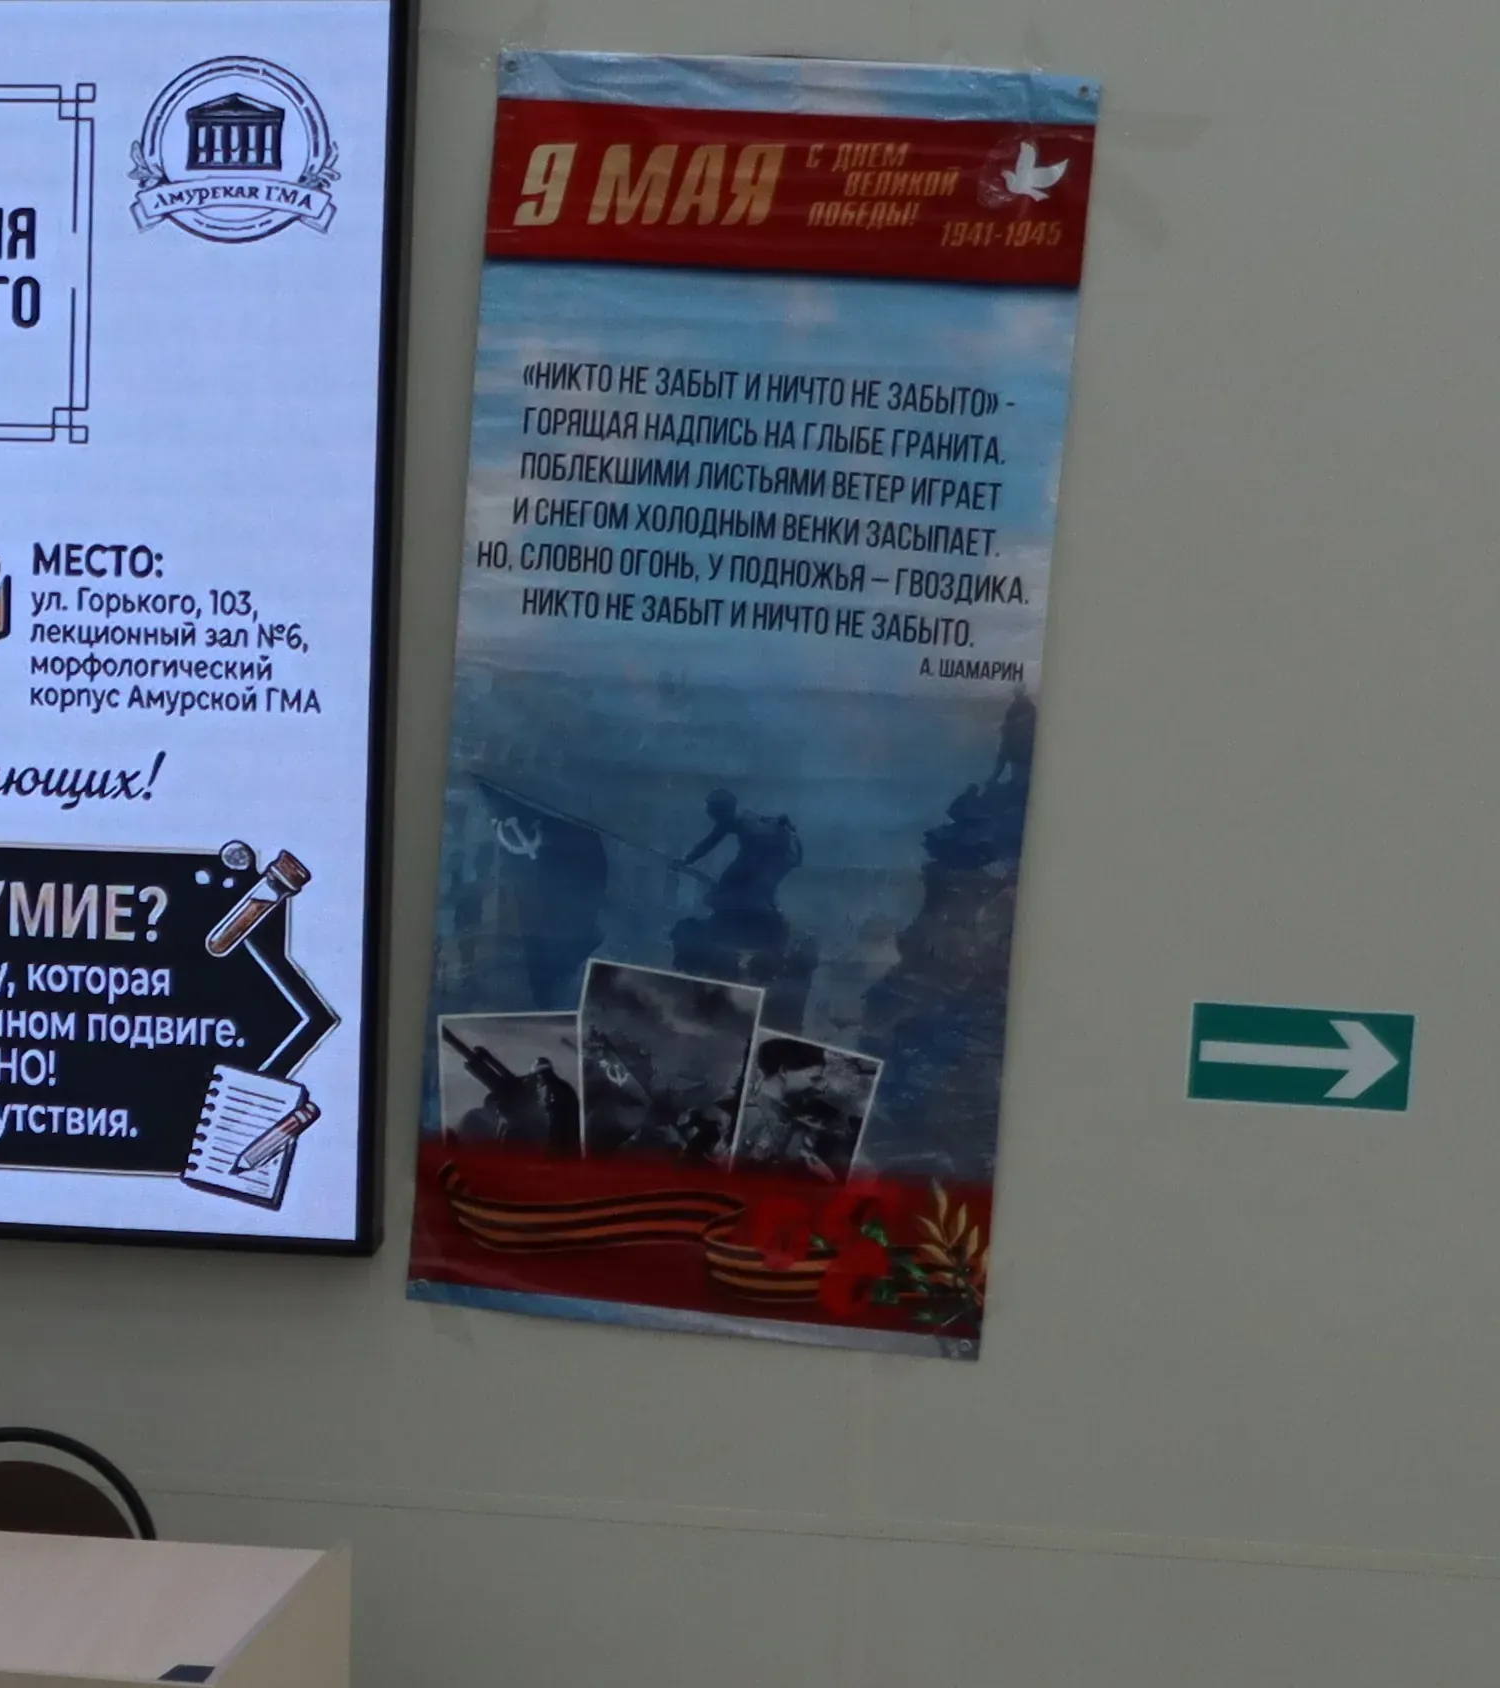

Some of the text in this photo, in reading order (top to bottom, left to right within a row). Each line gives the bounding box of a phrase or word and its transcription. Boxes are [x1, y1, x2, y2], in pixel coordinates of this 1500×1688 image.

[832, 143, 911, 172] ДНЕМ
[513, 142, 788, 226] 9 МАЯ
[844, 167, 960, 196] ВЕЛИКОЙ
[941, 221, 1062, 247] 1941-1945
[523, 361, 613, 393] «НИКТО
[618, 365, 650, 395] НЕ
[655, 367, 740, 400] ЗАБЫТ
[744, 372, 762, 401] И
[766, 373, 845, 407] НИЧТО
[850, 379, 882, 410] НЕ
[887, 381, 999, 418] ЗАБЫТО»
[522, 406, 1005, 465] ГОРЯЩАЯ НАДПИСЬ НА ГЛЫБЕ ГРАНИТА.
[520, 451, 1003, 511] ПОБЛЕКШИМИ ЛИСТЬЯМИ ВЕТЕР ИГРАЕТ
[512, 497, 997, 557] И СНЕГОМ ХОЛОДНЫМ ВЕНКИ ЗАСЫПАЕТ.
[32, 542, 164, 579] МЕСТО:
[477, 540, 513, 572] НО,
[520, 542, 614, 575] СЛОВНО
[619, 547, 700, 582] ОГОНЬ,
[708, 553, 724, 581] У
[729, 554, 866, 593] ПОДНОЖЬЯ
[894, 567, 1028, 606] ГВОЗДИКА.
[31, 586, 258, 623] ул. Горького, 103,
[522, 587, 974, 648] НИКТО НЕ ЗАБЫТ И НИЧТО НЕ ЗАБЫТО.
[30, 621, 309, 654] лекционный зал №6,
[30, 651, 273, 683] морфологический
[919, 657, 1024, 682] А. ШАМАРИН
[30, 684, 322, 717] корпус Амурской ГМА
[27, 963, 170, 1005] которая
[87, 1013, 245, 1050] подвиге.
